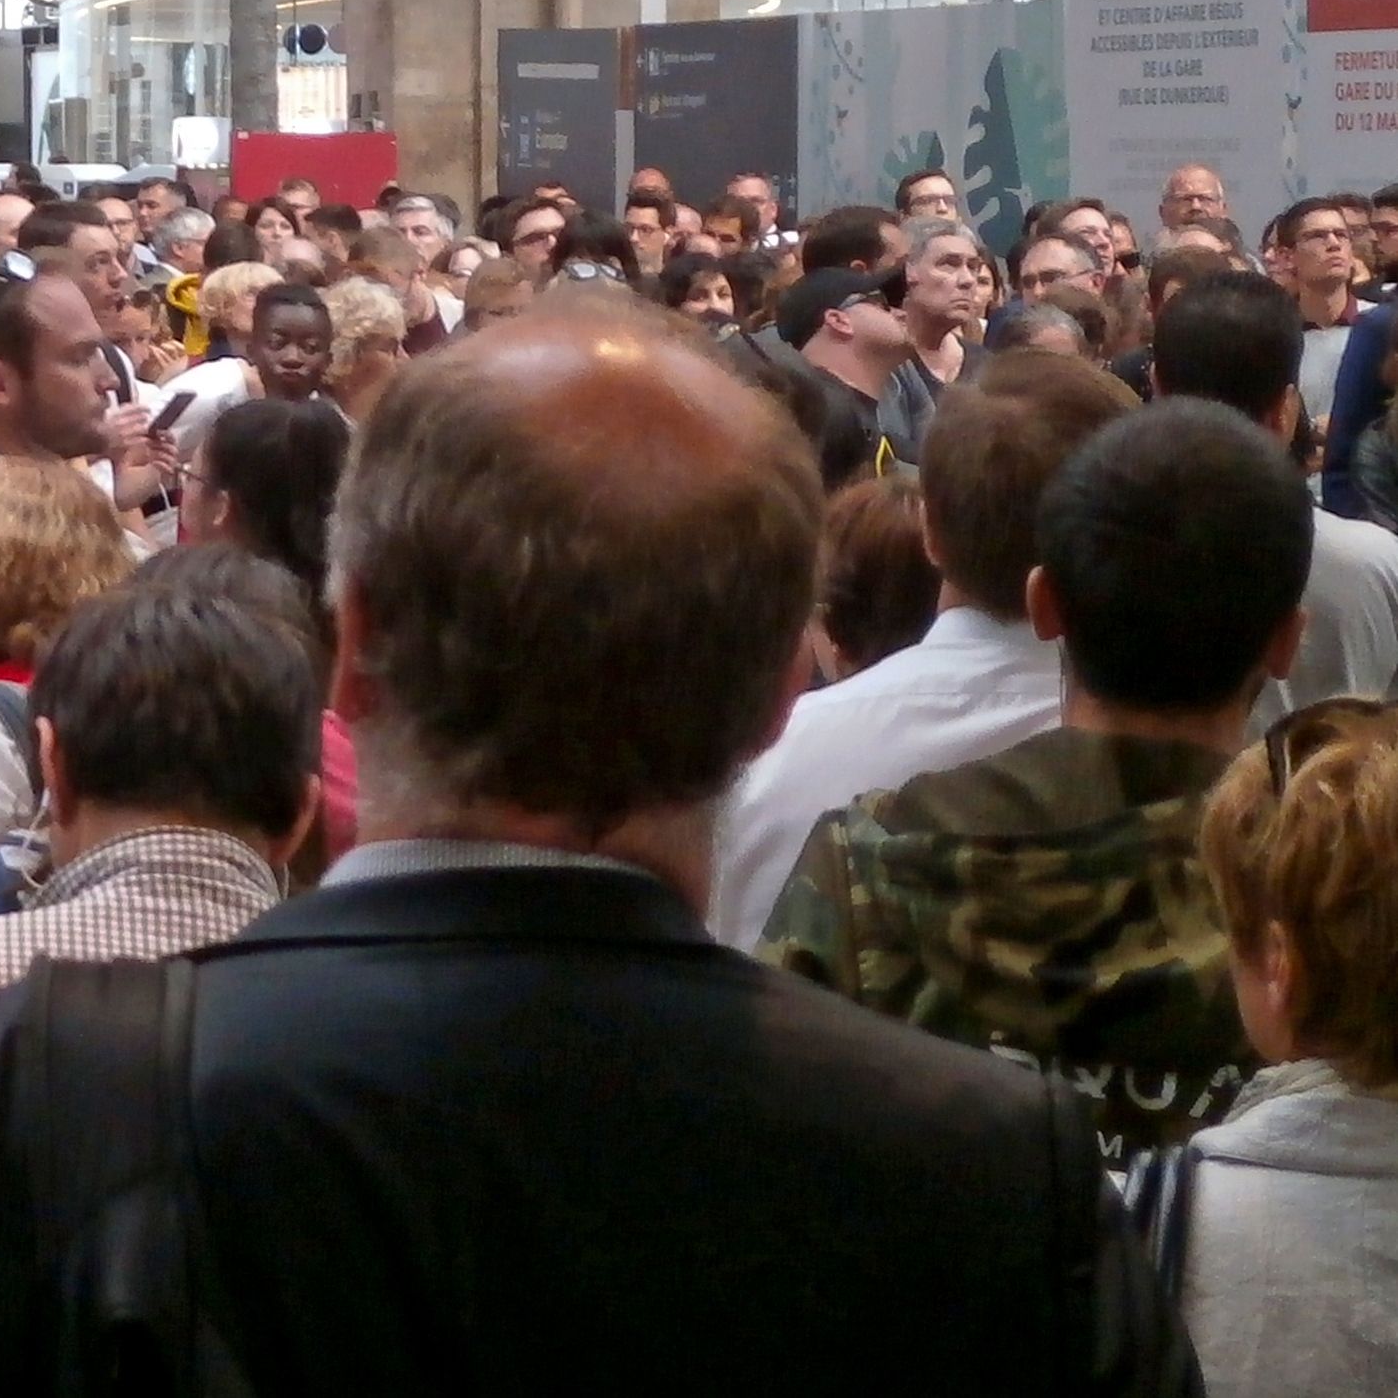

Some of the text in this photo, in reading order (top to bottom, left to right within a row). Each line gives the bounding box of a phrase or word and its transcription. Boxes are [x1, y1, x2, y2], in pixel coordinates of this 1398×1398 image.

[1113, 7, 1151, 26] CENTRE
[1090, 33, 1154, 53] ACCESSIBLES
[1156, 32, 1192, 51] DEPUIS
[1143, 58, 1203, 78] DE LA GARE
[1335, 50, 1398, 71] FERMETU
[1144, 88, 1157, 105] DE
[1335, 82, 1394, 101] GARE DU
[1335, 112, 1354, 131] DU
[1359, 112, 1373, 131] 12
